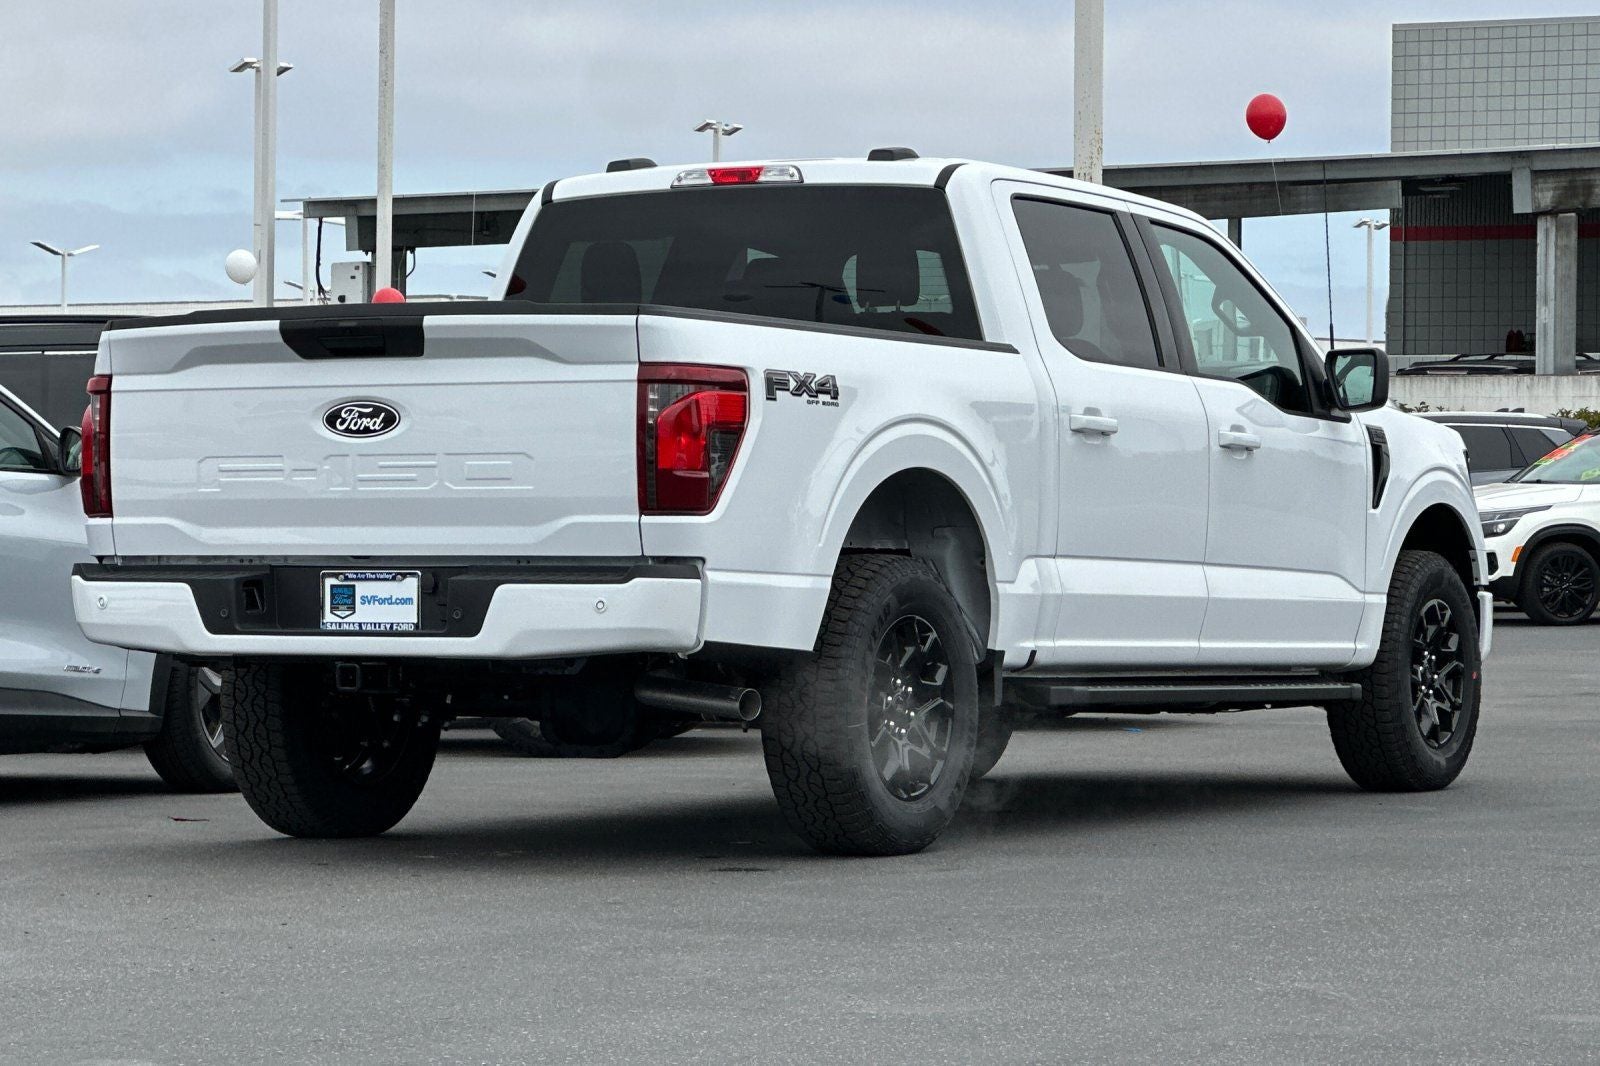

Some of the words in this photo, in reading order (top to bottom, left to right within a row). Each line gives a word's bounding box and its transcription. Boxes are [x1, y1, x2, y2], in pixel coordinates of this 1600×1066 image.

[763, 368, 839, 401] FX4
[821, 400, 839, 408] ROAD
[335, 406, 385, 432] Ford
[360, 595, 414, 605] SVFord.com
[326, 622, 359, 631] SALINAS
[361, 622, 392, 631] VALLEY
[392, 623, 415, 631] FORD
